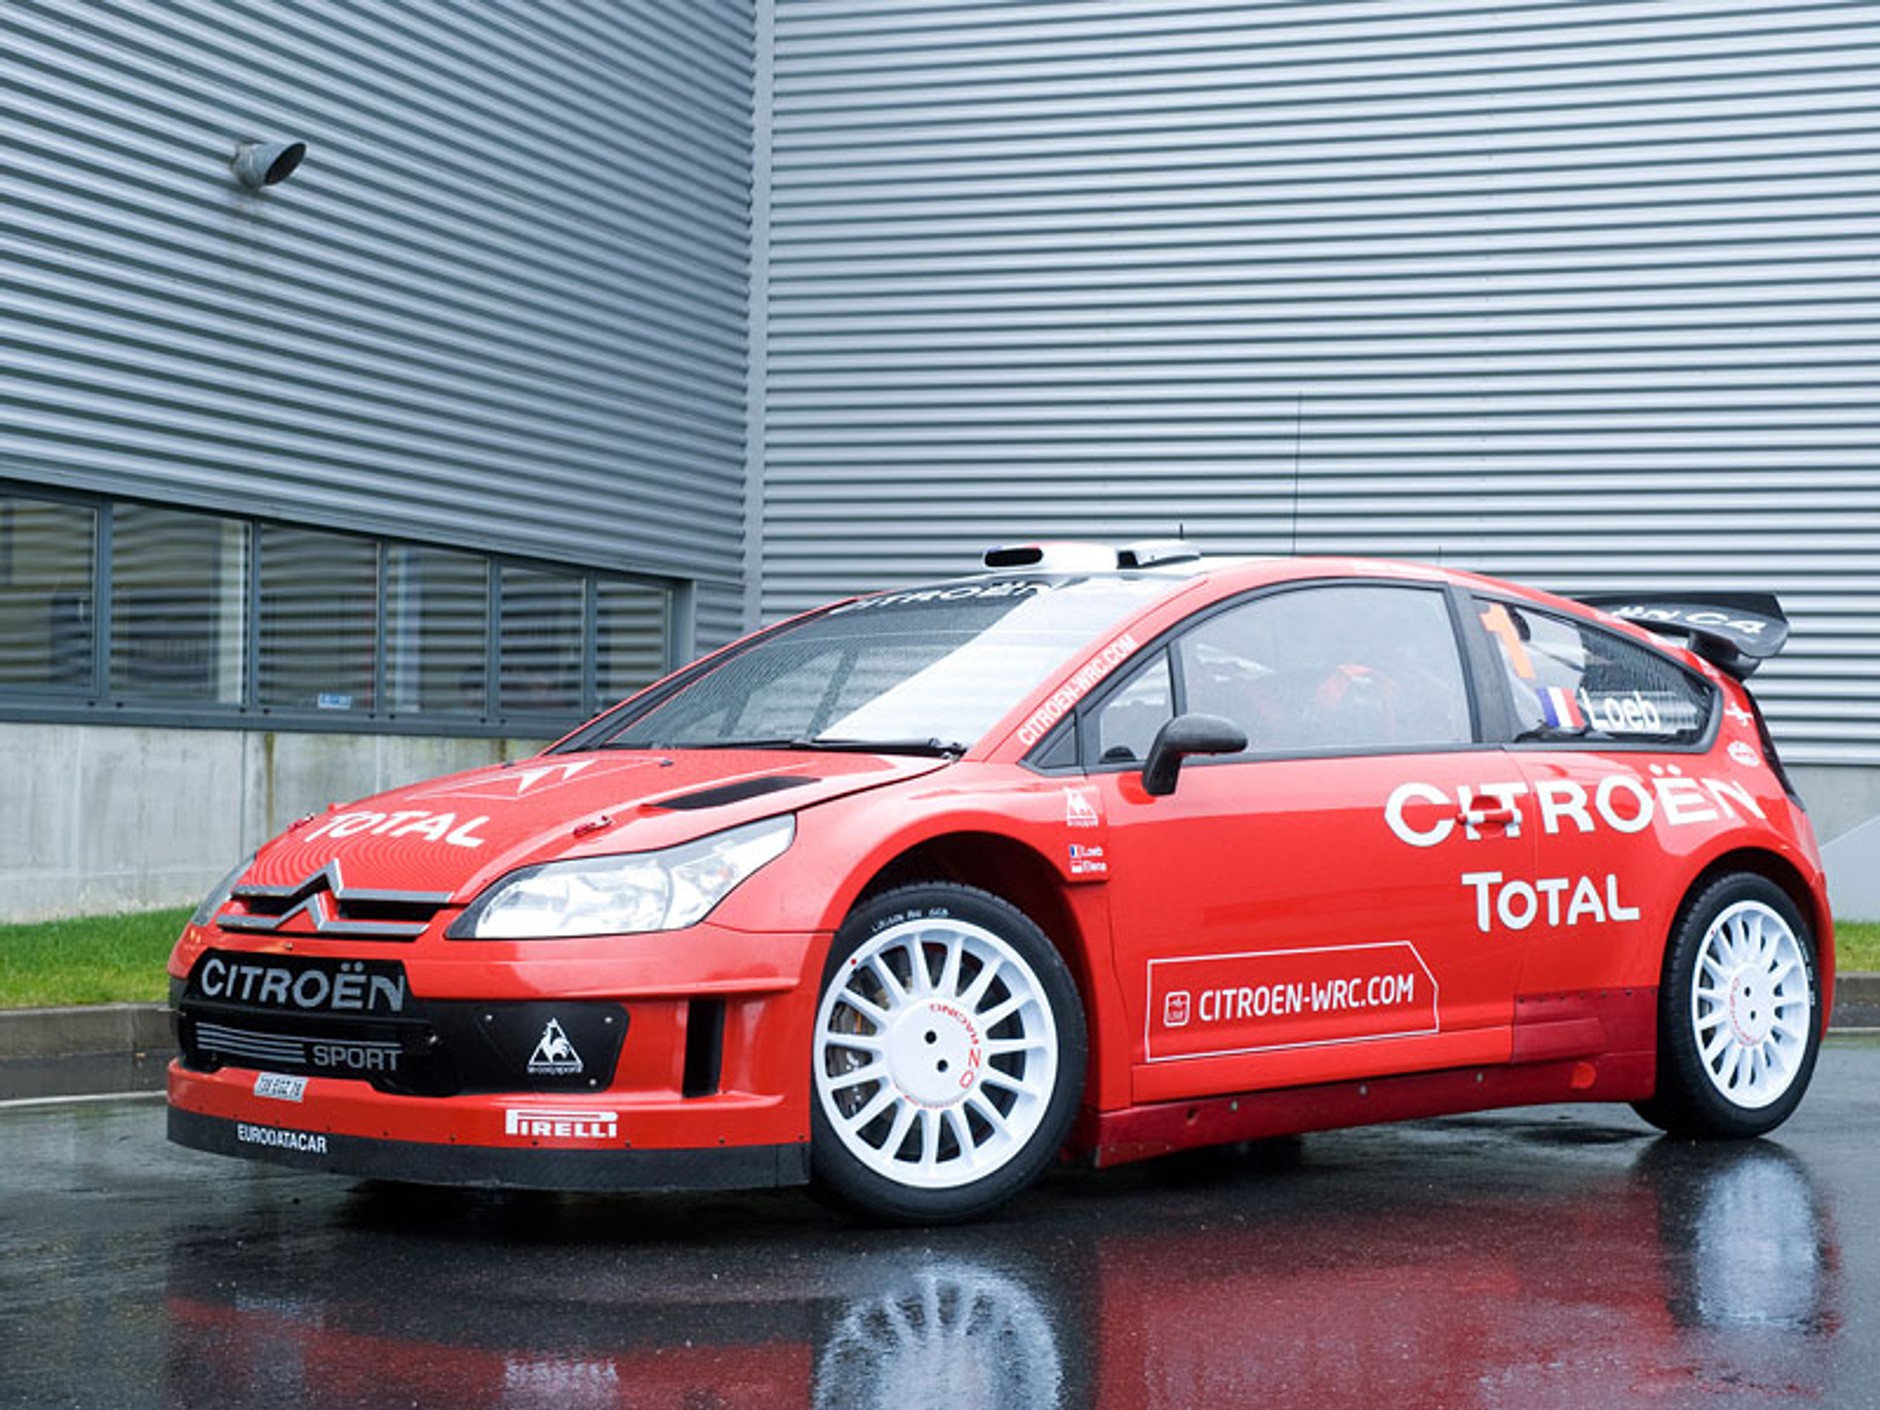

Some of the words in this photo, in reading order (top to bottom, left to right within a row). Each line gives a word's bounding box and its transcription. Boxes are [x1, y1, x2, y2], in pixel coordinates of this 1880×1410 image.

[1480, 602, 1537, 679] 1
[1018, 634, 1138, 746] CITROEN-WRC.COM
[1580, 686, 1661, 730] Loeb
[304, 811, 491, 848] TOTAL
[1385, 764, 1768, 847] CITROËN
[1461, 872, 1641, 933] TOTAL
[202, 958, 405, 1012] CITROËN
[1199, 974, 1415, 1022] CITROEN-WRC.COM
[312, 1044, 403, 1071] SPORT
[505, 1108, 619, 1138] PIRELLI
